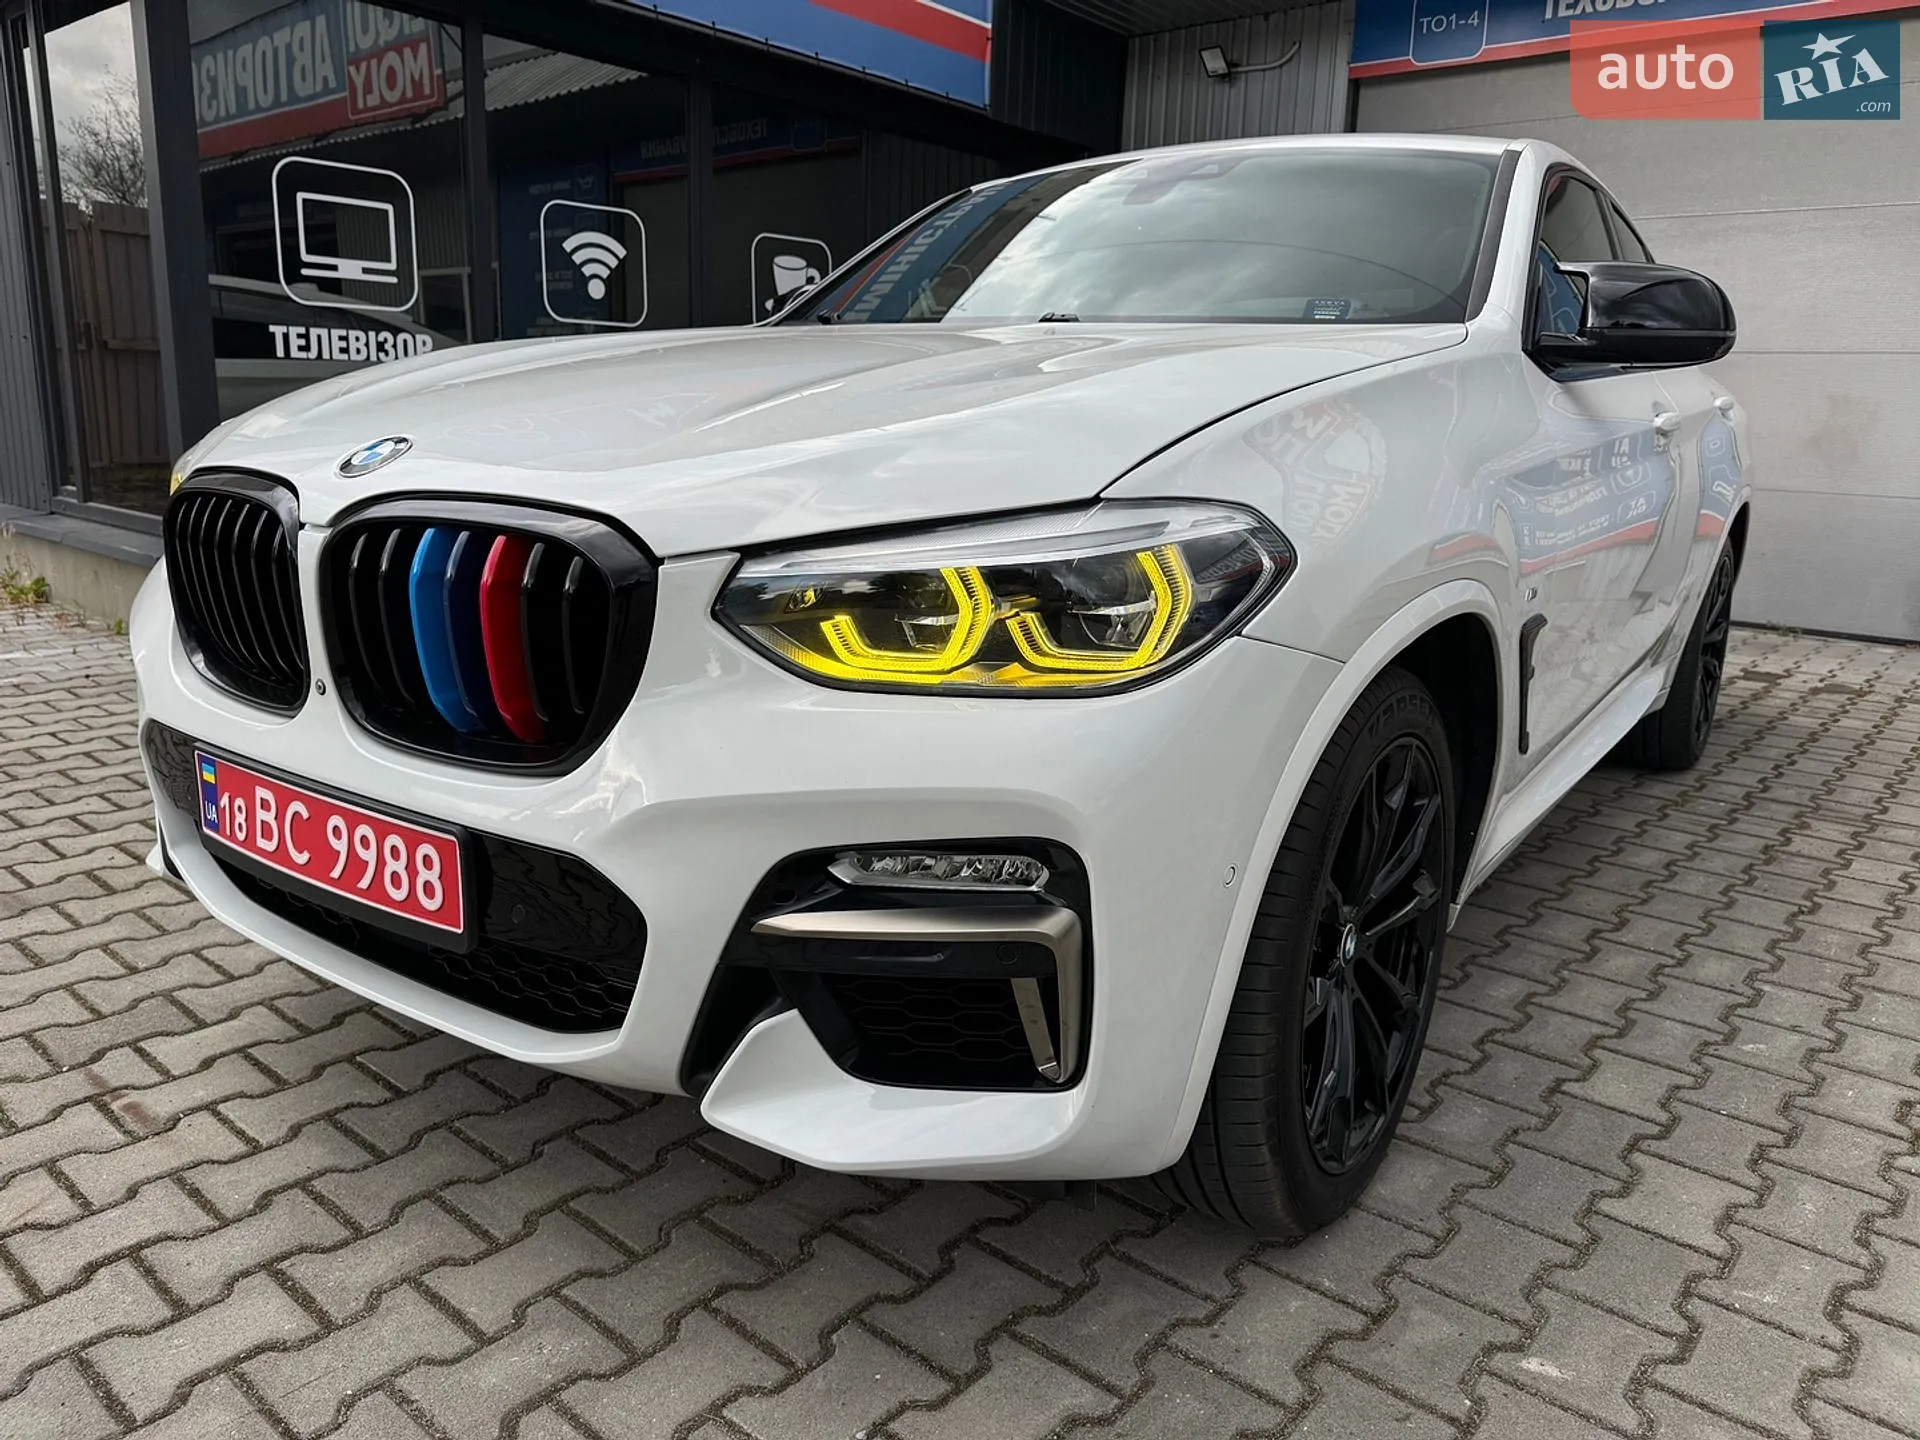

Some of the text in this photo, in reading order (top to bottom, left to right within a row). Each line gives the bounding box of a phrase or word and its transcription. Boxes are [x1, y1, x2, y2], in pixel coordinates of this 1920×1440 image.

[268, 324, 433, 362] ТЕЛЕВІЗОР
[205, 801, 218, 824] UA
[220, 785, 443, 912] 18 BC 9988
